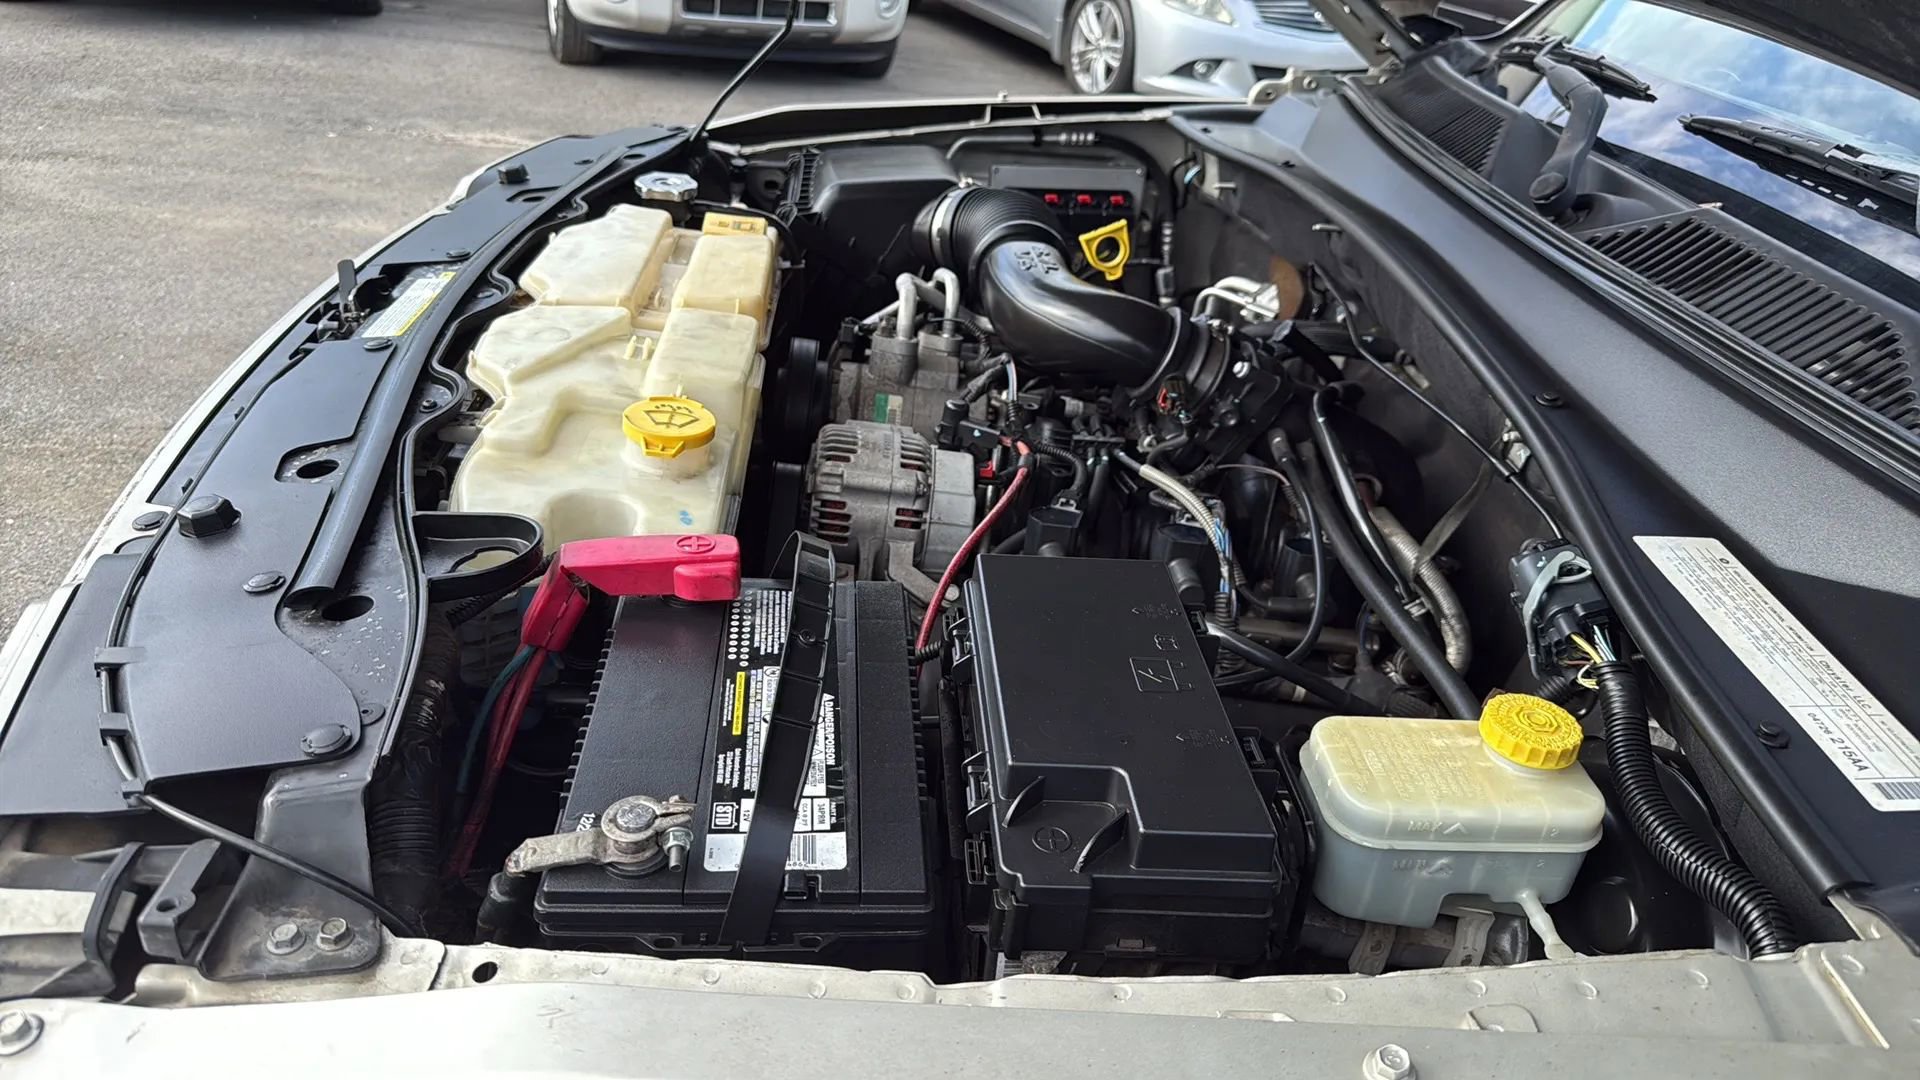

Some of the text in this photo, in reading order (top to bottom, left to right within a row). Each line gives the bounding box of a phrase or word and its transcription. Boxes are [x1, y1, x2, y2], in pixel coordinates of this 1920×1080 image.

[1819, 660, 1854, 692] Chrysler
[1852, 695, 1872, 709] LLC
[1808, 712, 1833, 735] 04726
[1830, 737, 1871, 771] 215AA
[715, 805, 733, 826] STD
[742, 809, 751, 822] 12V
[817, 803, 826, 824] 34PRM
[1407, 820, 1443, 832] MAX
